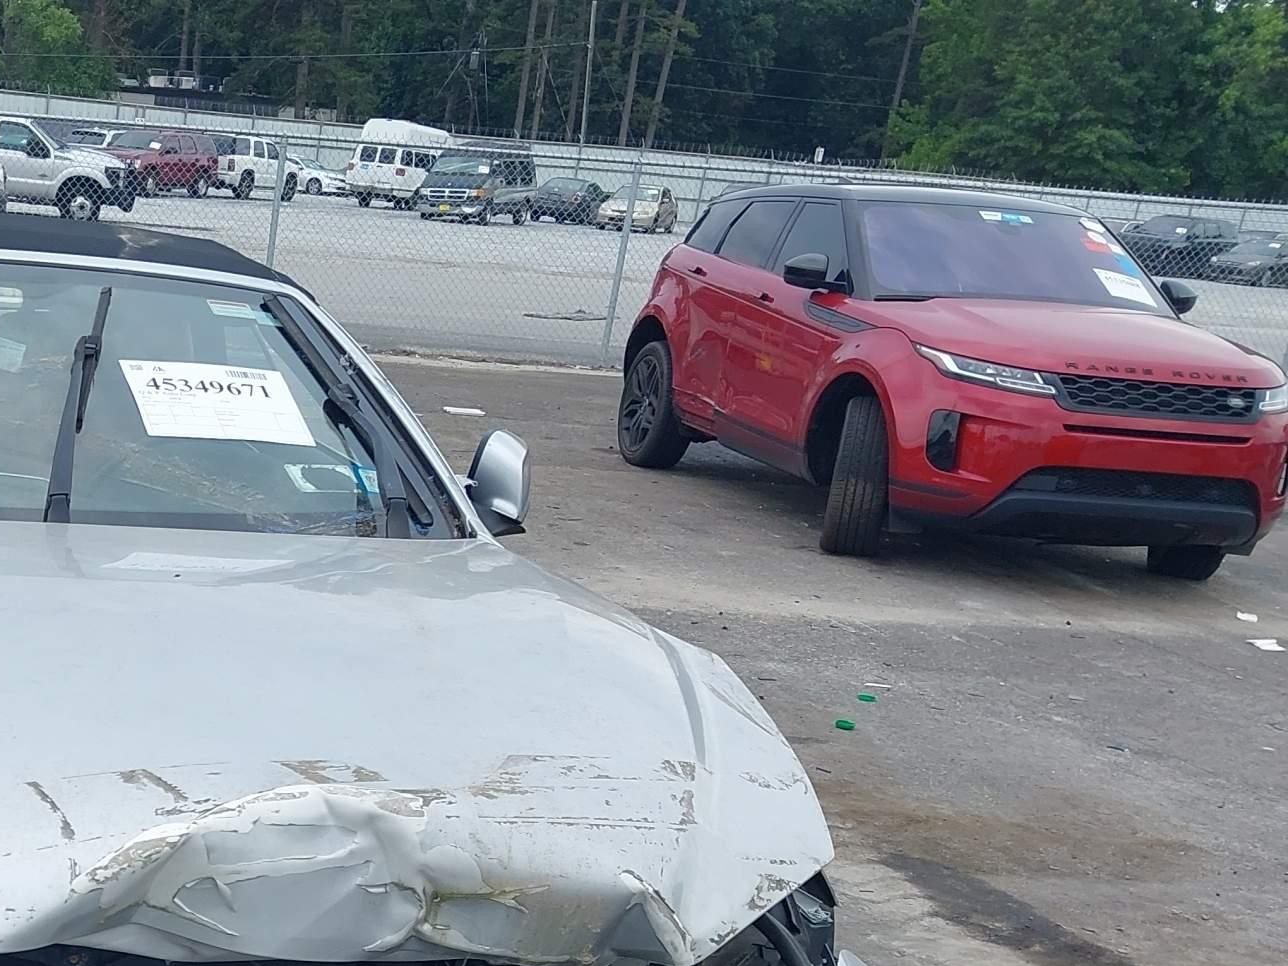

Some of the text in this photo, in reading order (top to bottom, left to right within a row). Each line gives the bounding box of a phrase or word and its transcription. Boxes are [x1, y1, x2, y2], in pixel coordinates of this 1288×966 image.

[1065, 362, 1249, 383] RANGE ROVER
[146, 377, 272, 398] 45349671
